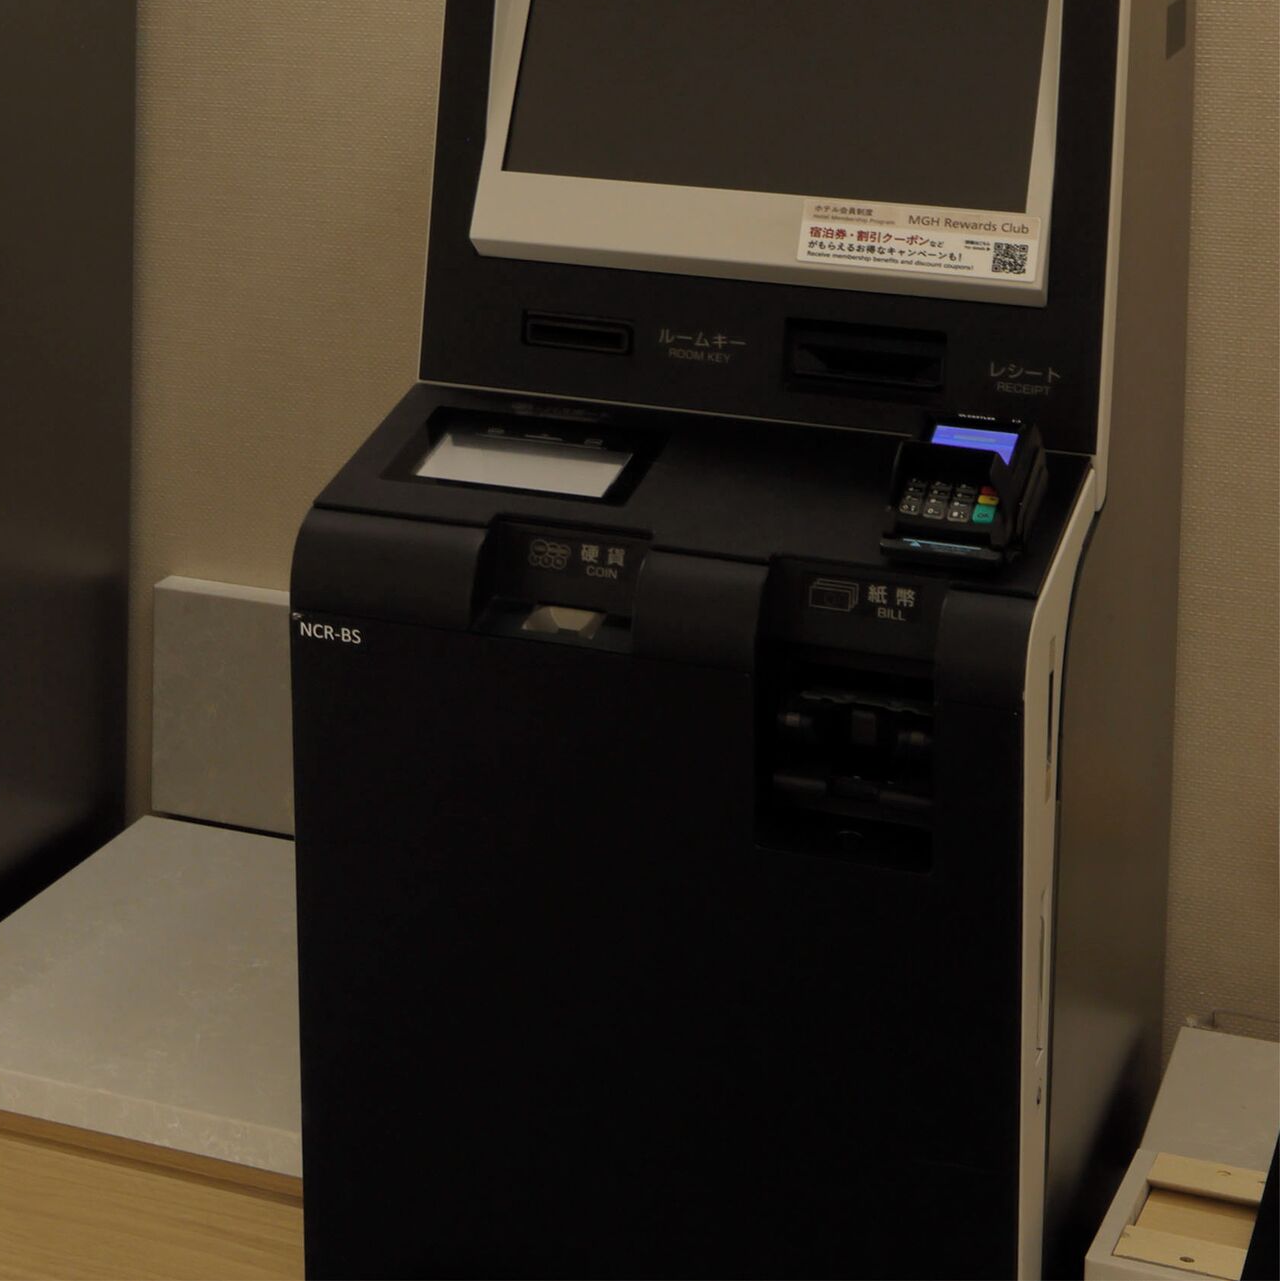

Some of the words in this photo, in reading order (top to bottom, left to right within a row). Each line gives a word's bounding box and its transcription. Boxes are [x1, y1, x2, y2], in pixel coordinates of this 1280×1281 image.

[908, 215, 940, 227] MGH
[945, 218, 997, 232] Rewards
[1001, 222, 1029, 235] Club
[832, 253, 872, 262] membership
[873, 256, 899, 264] benefits
[900, 258, 913, 266] and
[914, 260, 942, 268] discount
[658, 328, 747, 349] ルームキー
[668, 347, 704, 361] ROOM
[707, 352, 731, 364] KEY
[990, 361, 1061, 383] レシート
[996, 381, 1051, 396] RECEIPT
[586, 565, 618, 580] COIN
[877, 607, 906, 622] BILL
[300, 621, 362, 645] NCR-BS
